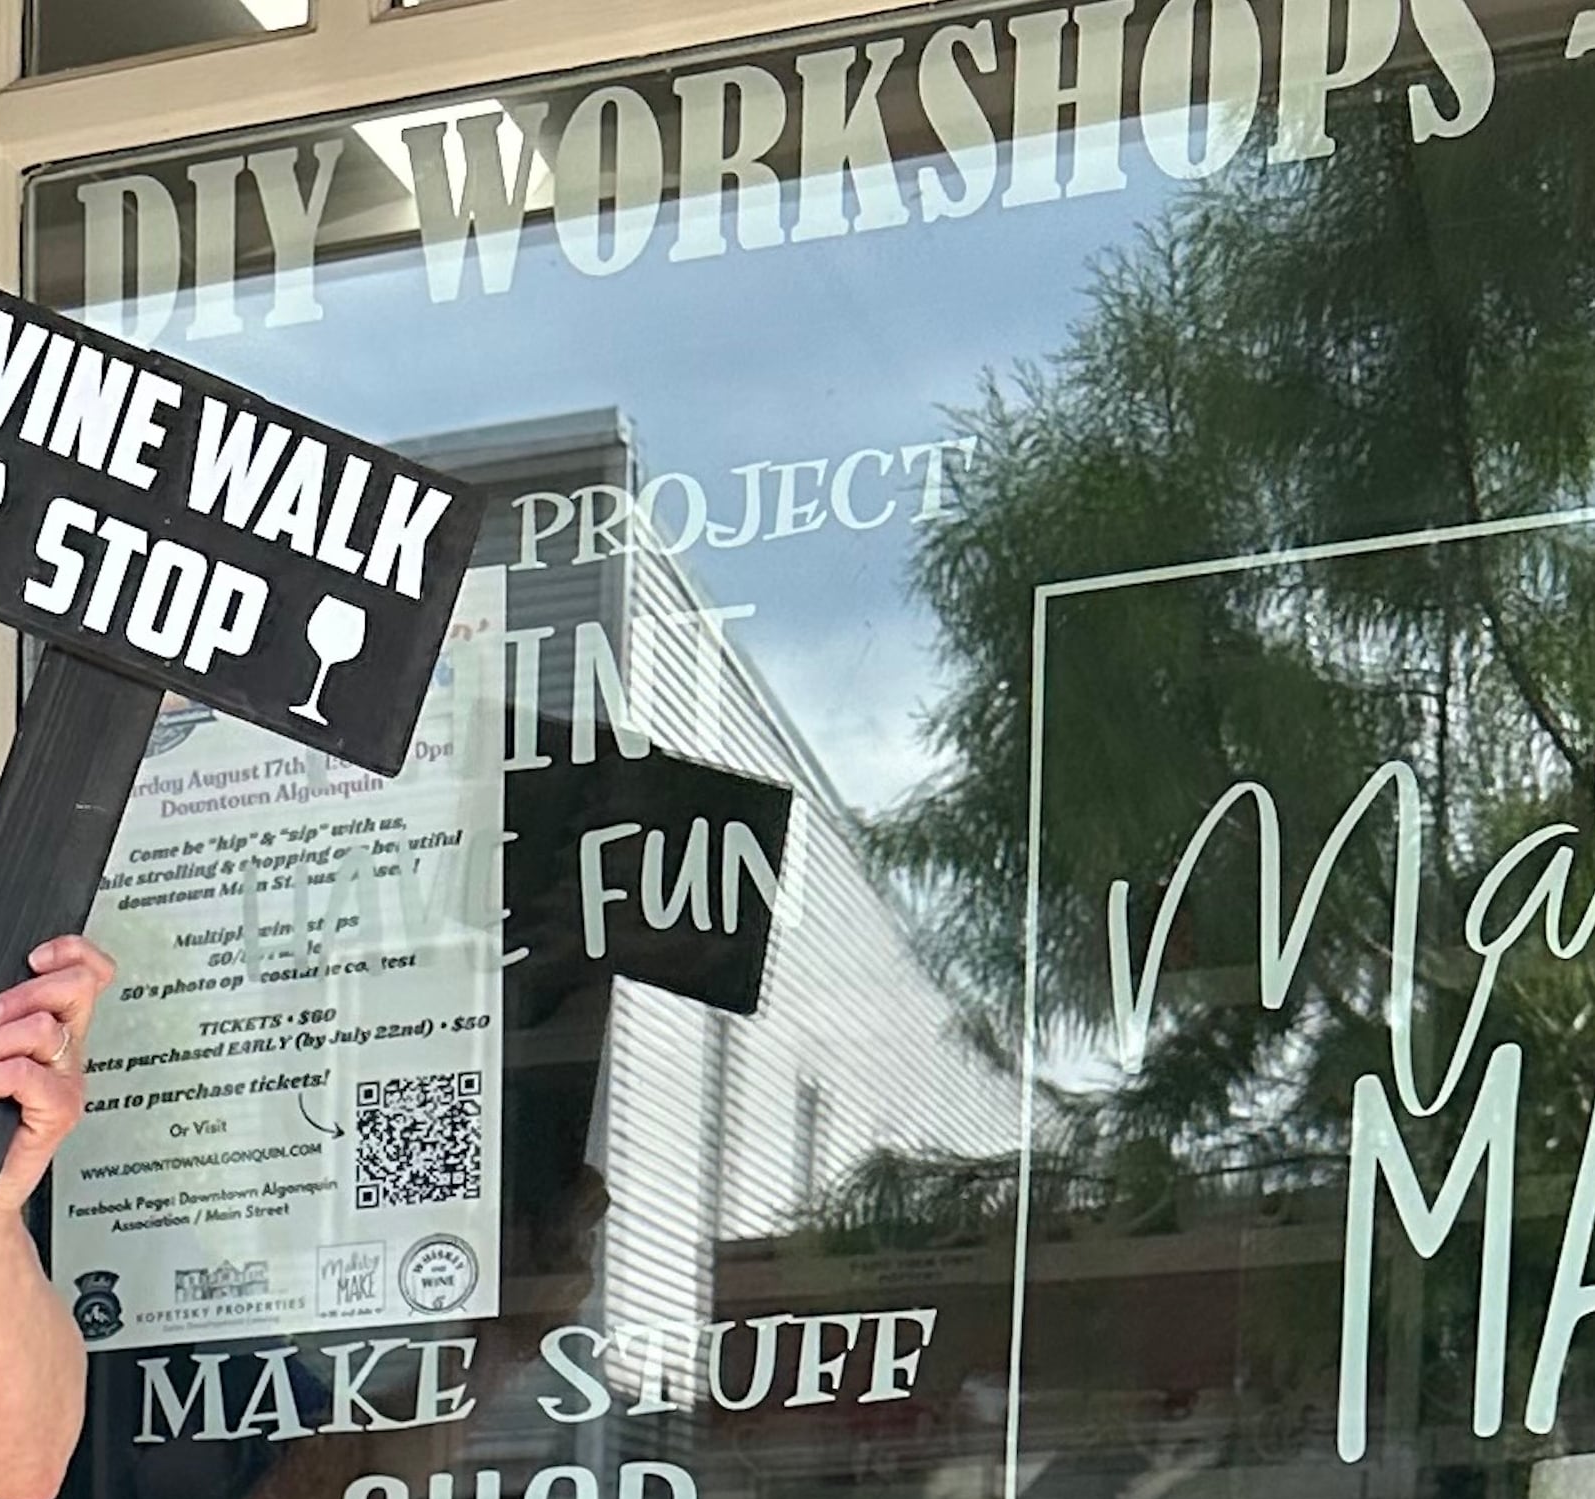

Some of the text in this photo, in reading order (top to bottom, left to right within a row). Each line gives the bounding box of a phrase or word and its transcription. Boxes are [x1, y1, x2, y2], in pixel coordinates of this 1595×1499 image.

[76, 0, 1497, 350] DIY WORKSHOPS
[187, 395, 452, 600] WALK
[510, 435, 982, 577] PROJECT
[23, 496, 269, 675] STOP
[189, 762, 260, 791] August
[264, 756, 305, 777] 17th
[162, 777, 383, 818] Downtown Algonquin
[130, 846, 178, 865] Come
[183, 840, 204, 856] be
[259, 830, 275, 847] &
[331, 818, 376, 836] with
[136, 861, 218, 885] strolling
[220, 861, 235, 875] &
[580, 818, 803, 960] FUN
[118, 888, 214, 911] downtown
[162, 979, 217, 998] photo
[220, 975, 244, 993] op
[129, 1042, 223, 1070] purchased
[227, 1035, 289, 1057] EARLY
[329, 1026, 370, 1045] July
[451, 1014, 490, 1032] $50
[199, 1007, 336, 1036] TICKETS $60
[124, 1093, 144, 1109] to
[147, 1080, 246, 1106] purchase
[250, 1069, 331, 1094] tickets!
[170, 1119, 227, 1138] Or Visit
[68, 1199, 132, 1220] Facebook
[179, 1187, 258, 1205] Downtown
[261, 1178, 338, 1200] Algonquin
[112, 1214, 189, 1234] Association
[206, 1206, 243, 1223] Main
[246, 1202, 289, 1219] Street
[216, 1296, 306, 1316] PROPERTIES
[132, 1306, 939, 1444] MAKE STUFF
